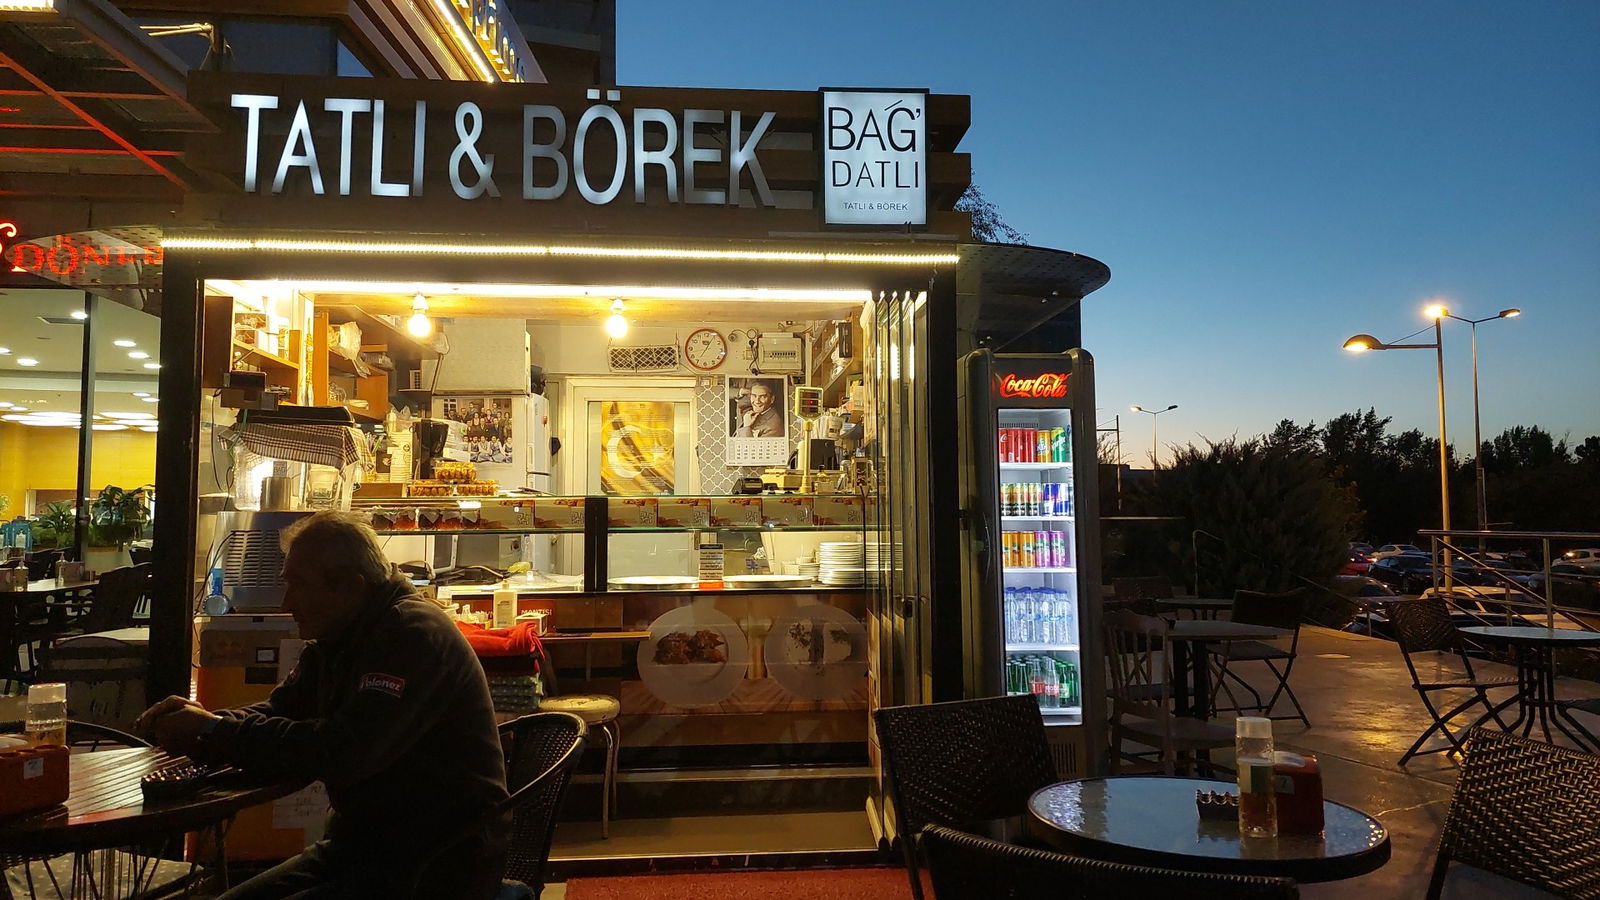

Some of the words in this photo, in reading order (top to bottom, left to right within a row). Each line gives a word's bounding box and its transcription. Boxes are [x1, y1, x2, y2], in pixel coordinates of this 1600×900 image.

[231, 94, 426, 197] TATLI
[449, 101, 501, 200] &
[523, 88, 777, 209] BÖREK
[832, 160, 919, 188] DATLI
[843, 202, 866, 210] TATLI
[868, 202, 875, 210] &
[877, 201, 908, 210] BÖREK
[1000, 373, 1068, 398] Coca-Cola
